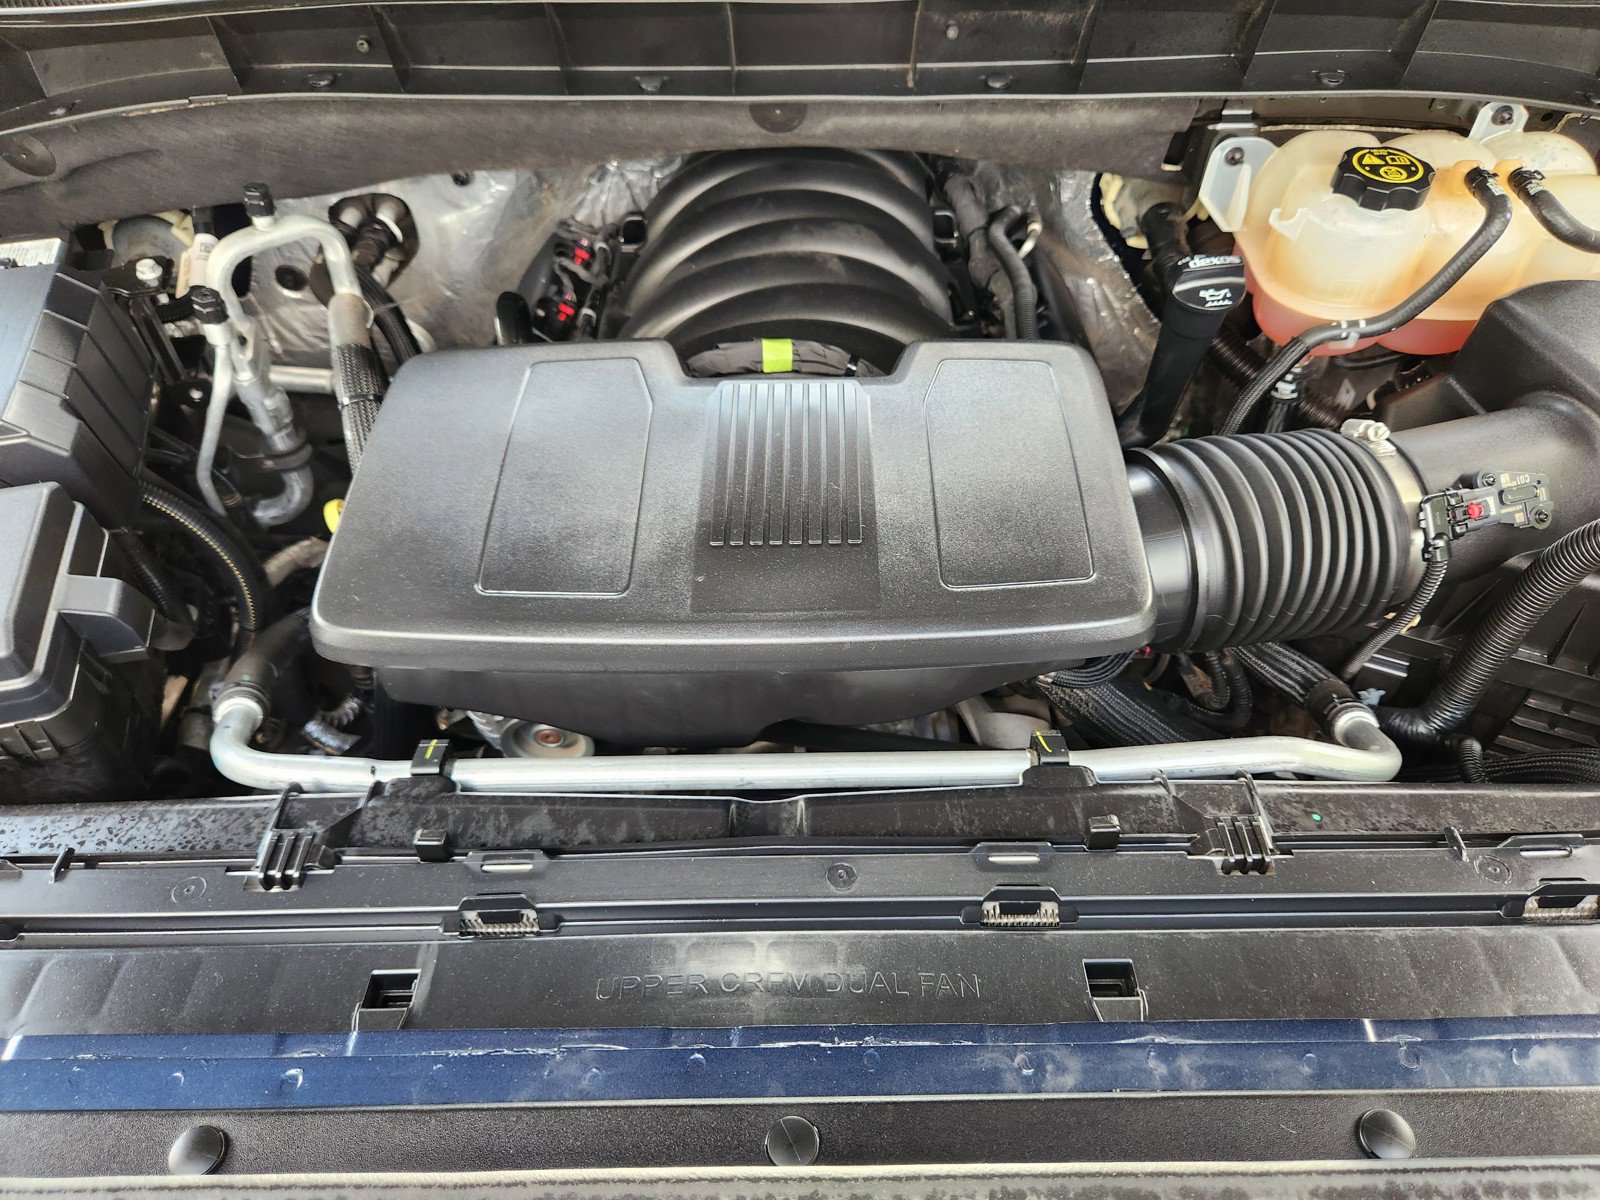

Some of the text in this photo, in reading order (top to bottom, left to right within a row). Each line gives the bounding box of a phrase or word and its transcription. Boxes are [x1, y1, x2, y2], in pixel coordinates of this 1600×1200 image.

[1188, 255, 1242, 268] dexos
[595, 972, 709, 1000] UPPER
[824, 971, 910, 996] DUAL
[918, 972, 981, 998] FAN
